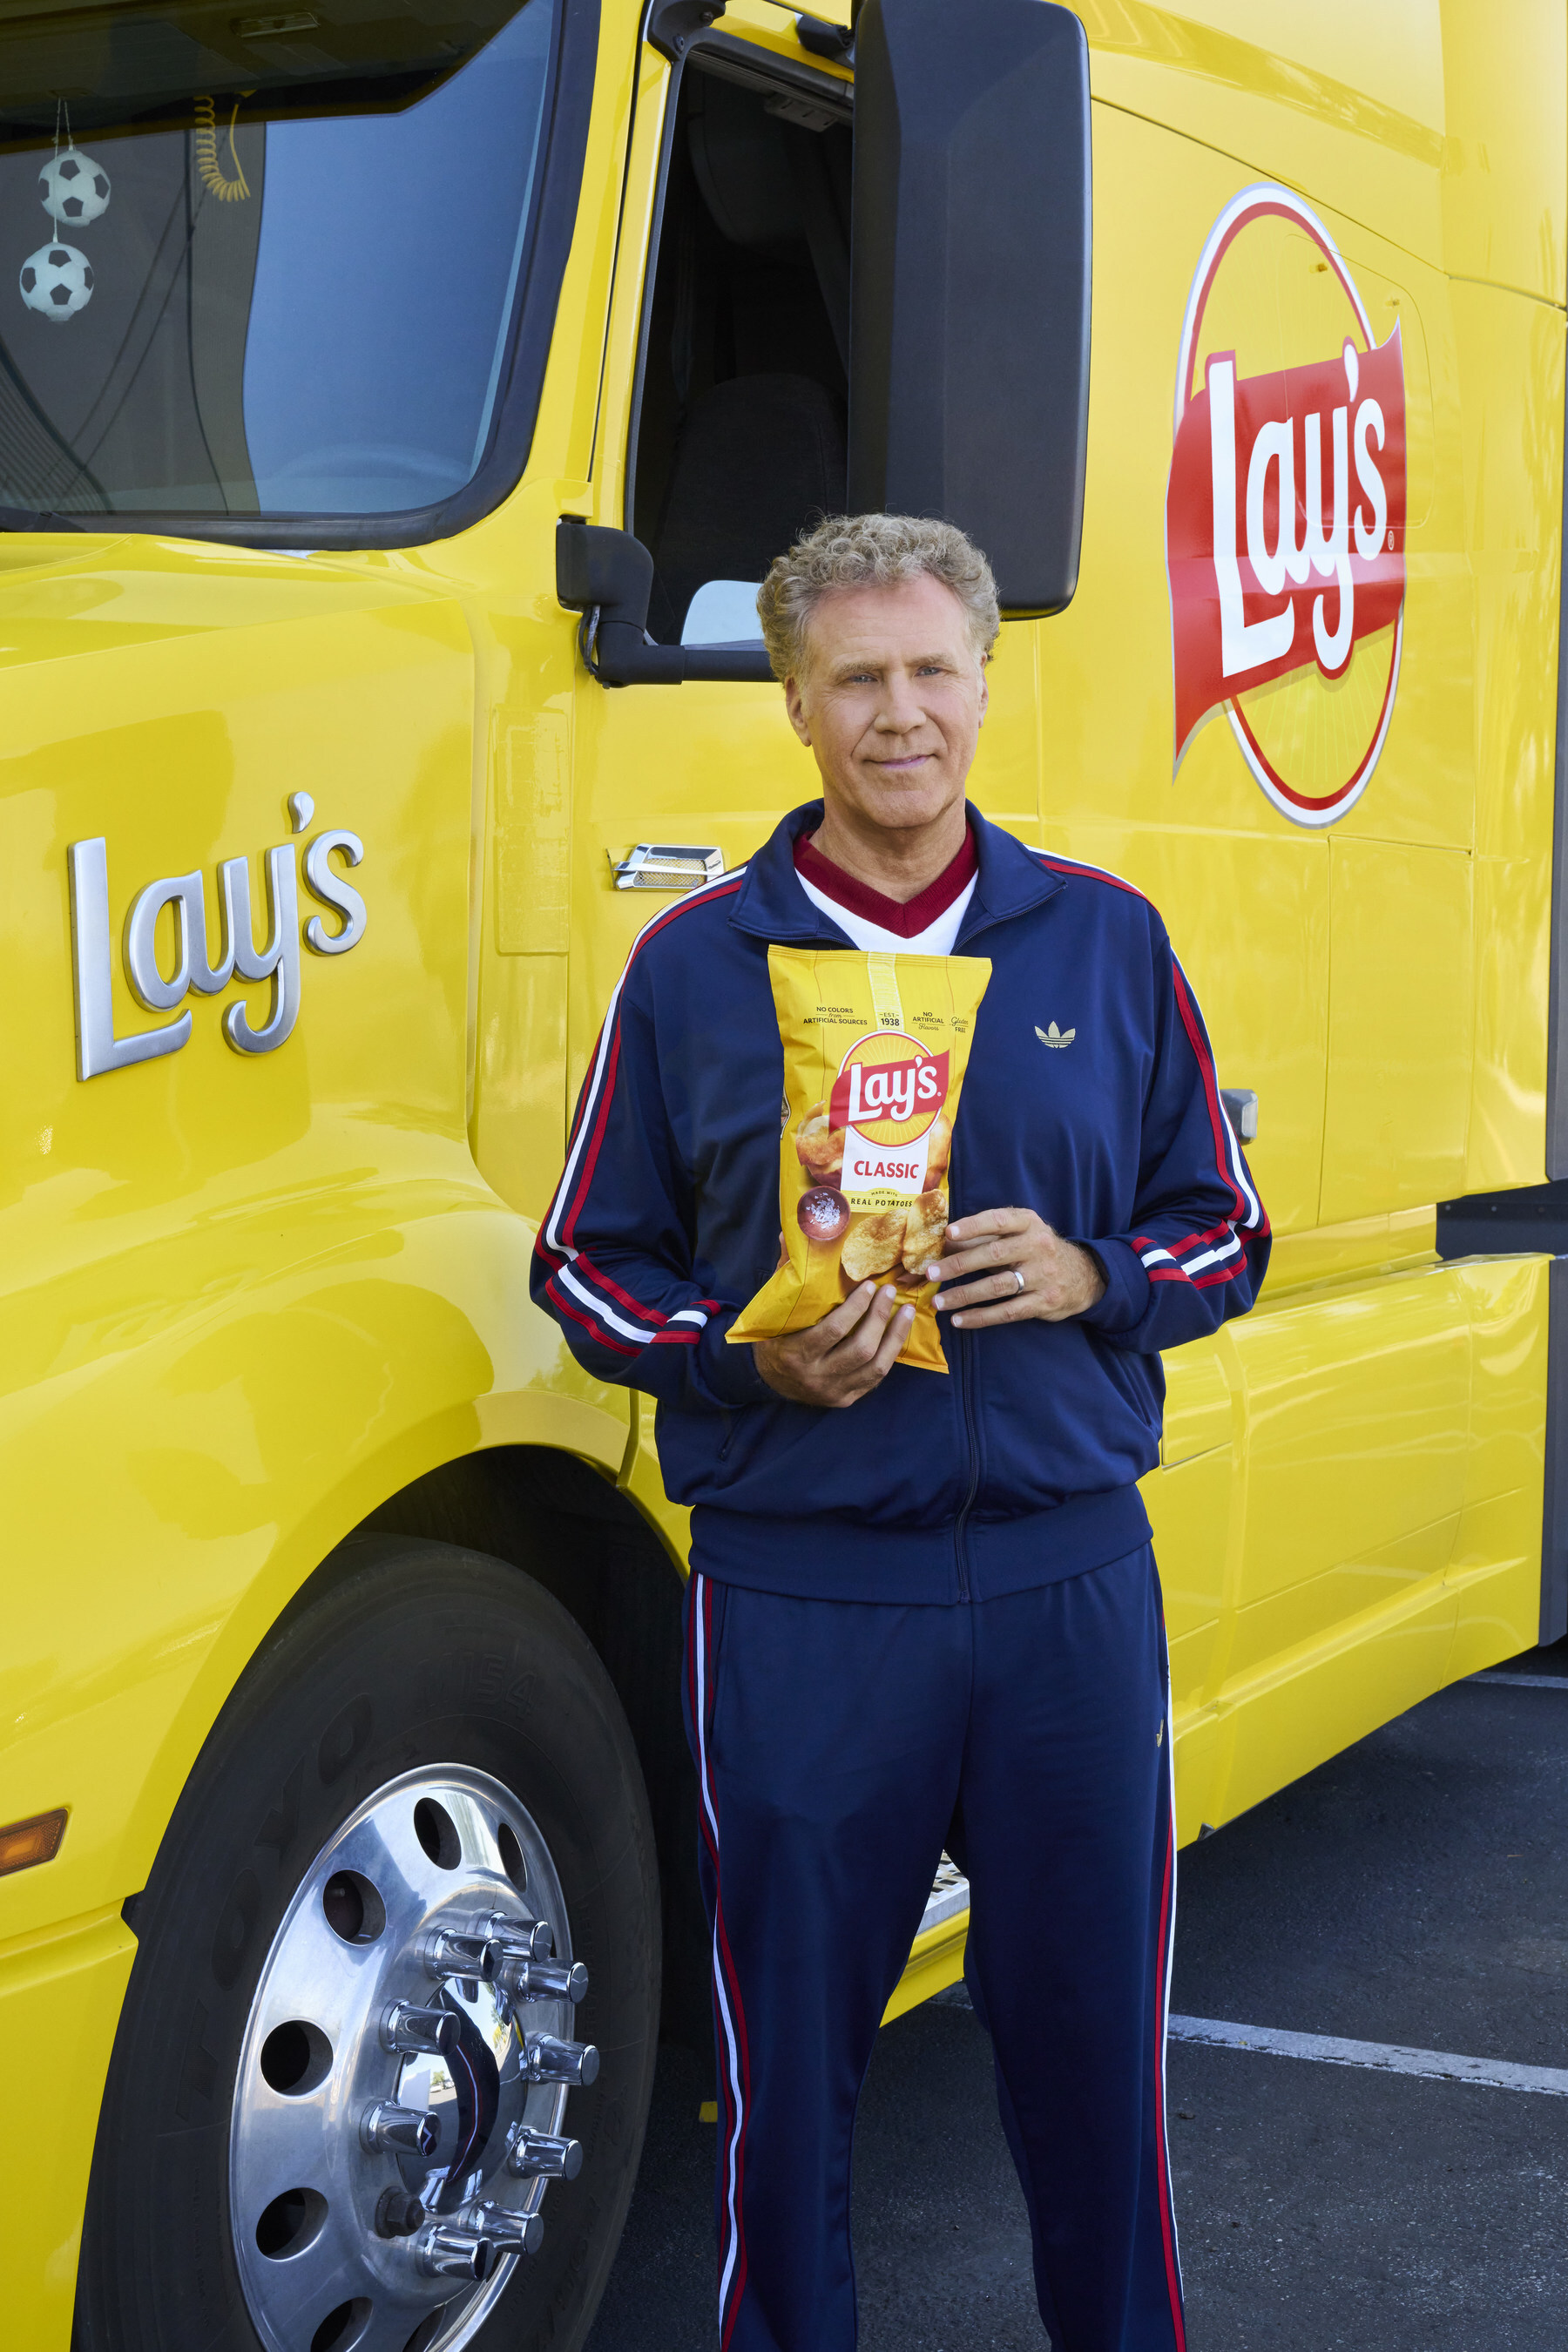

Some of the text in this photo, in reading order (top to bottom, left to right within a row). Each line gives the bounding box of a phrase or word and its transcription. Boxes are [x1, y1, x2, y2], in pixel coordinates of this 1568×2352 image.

[1208, 343, 1387, 679] Lay's
[68, 791, 368, 1082] Lay's
[881, 1017, 900, 1026] 1938
[848, 1056, 937, 1122] Lay's
[854, 1160, 919, 1179] CLASSIC
[175, 1693, 373, 2123] TOYO
